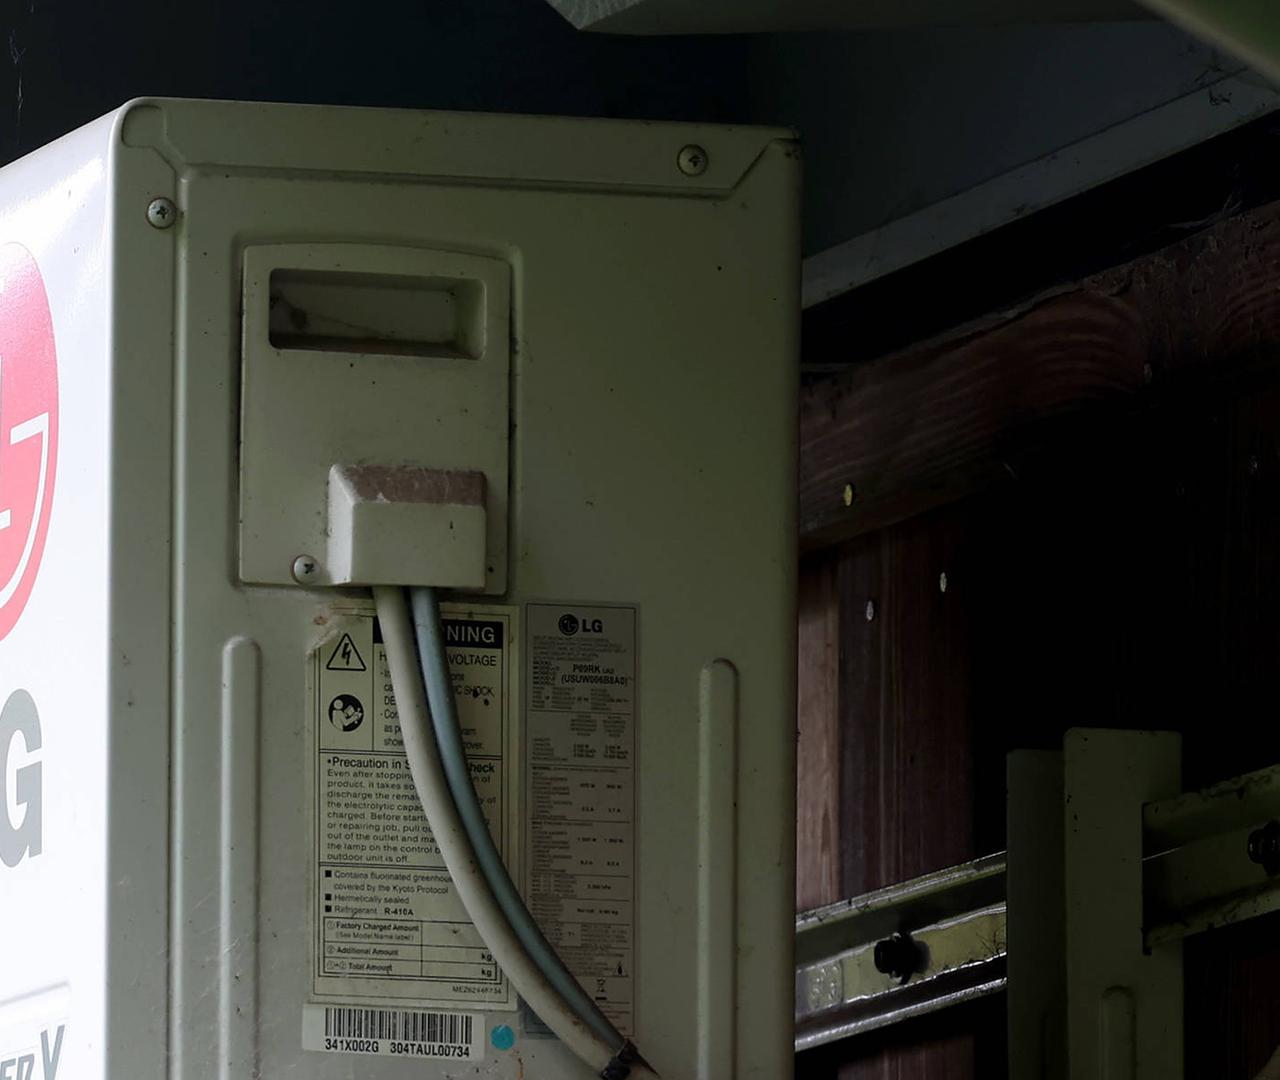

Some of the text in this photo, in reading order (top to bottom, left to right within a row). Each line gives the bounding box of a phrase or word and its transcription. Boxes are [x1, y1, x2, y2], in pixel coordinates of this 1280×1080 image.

[582, 619, 602, 633] LG
[447, 626, 495, 643] NING
[449, 655, 496, 666] VOLTAGE
[332, 757, 388, 768] Precaution
[392, 759, 401, 769] in
[328, 791, 372, 799] discharge
[339, 823, 380, 831] repairing
[403, 825, 419, 833] pull
[344, 843, 366, 851] lamp
[335, 870, 368, 879] Contains
[367, 884, 375, 892] by
[392, 885, 415, 894] Kyoto
[417, 886, 448, 894] Protocol
[334, 894, 381, 903] Hermetically
[336, 921, 361, 930] Factory
[363, 923, 391, 931] Charged
[336, 947, 370, 955] Additional
[481, 953, 492, 962] kg
[348, 962, 366, 970] Total
[367, 963, 392, 971] Amount
[481, 969, 492, 977] kg
[325, 1038, 379, 1052] 341X002G
